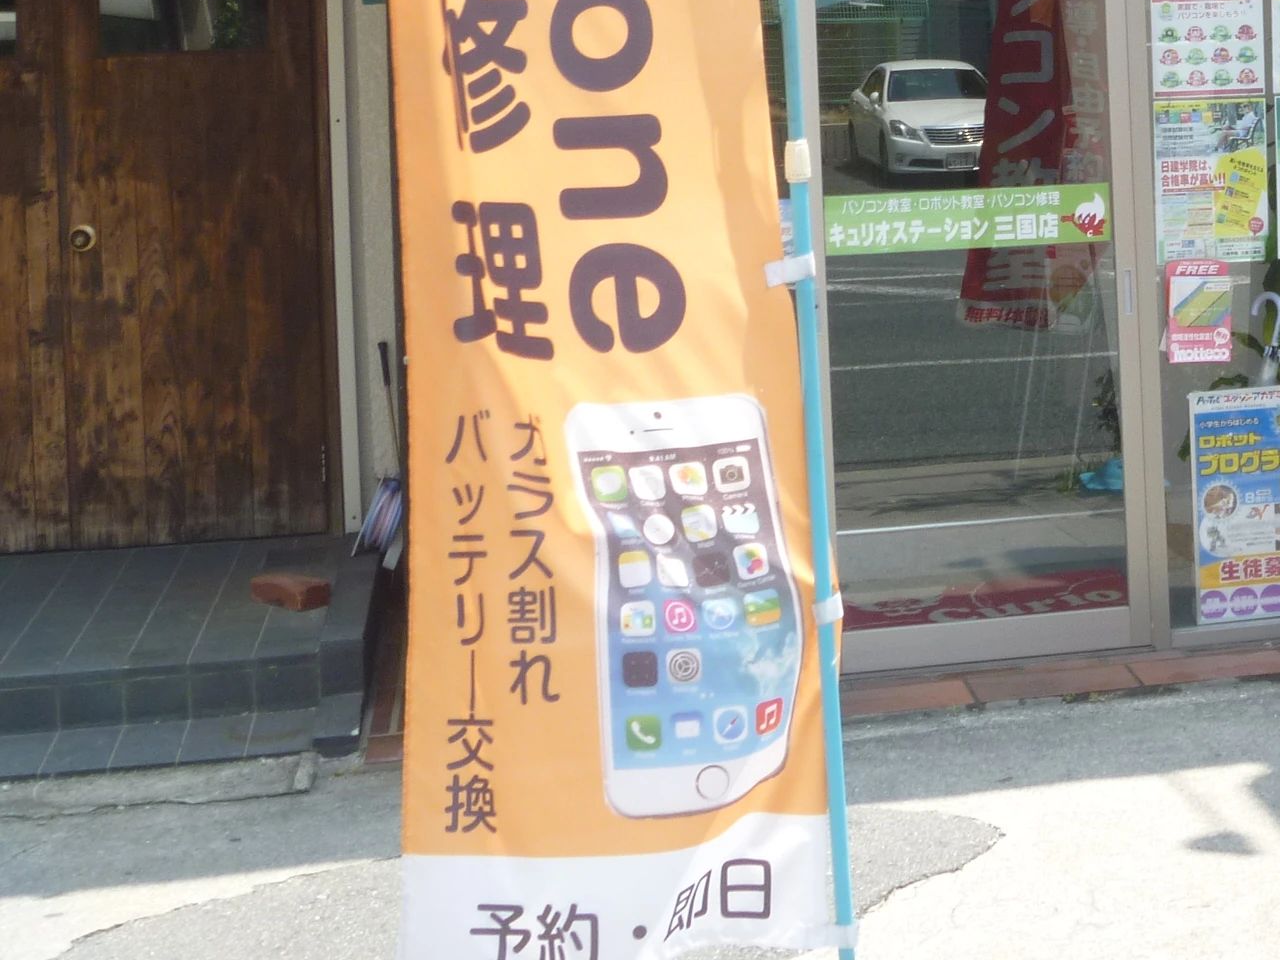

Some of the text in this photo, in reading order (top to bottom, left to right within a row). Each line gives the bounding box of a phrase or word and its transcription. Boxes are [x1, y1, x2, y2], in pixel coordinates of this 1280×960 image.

[829, 218, 989, 248] キュリオステーション
[994, 213, 1059, 241] 三国店
[1175, 264, 1221, 275] FREE
[1199, 432, 1264, 449] ロボット
[507, 413, 560, 705] ガラス割れ
[444, 409, 497, 834] バッテリー交換
